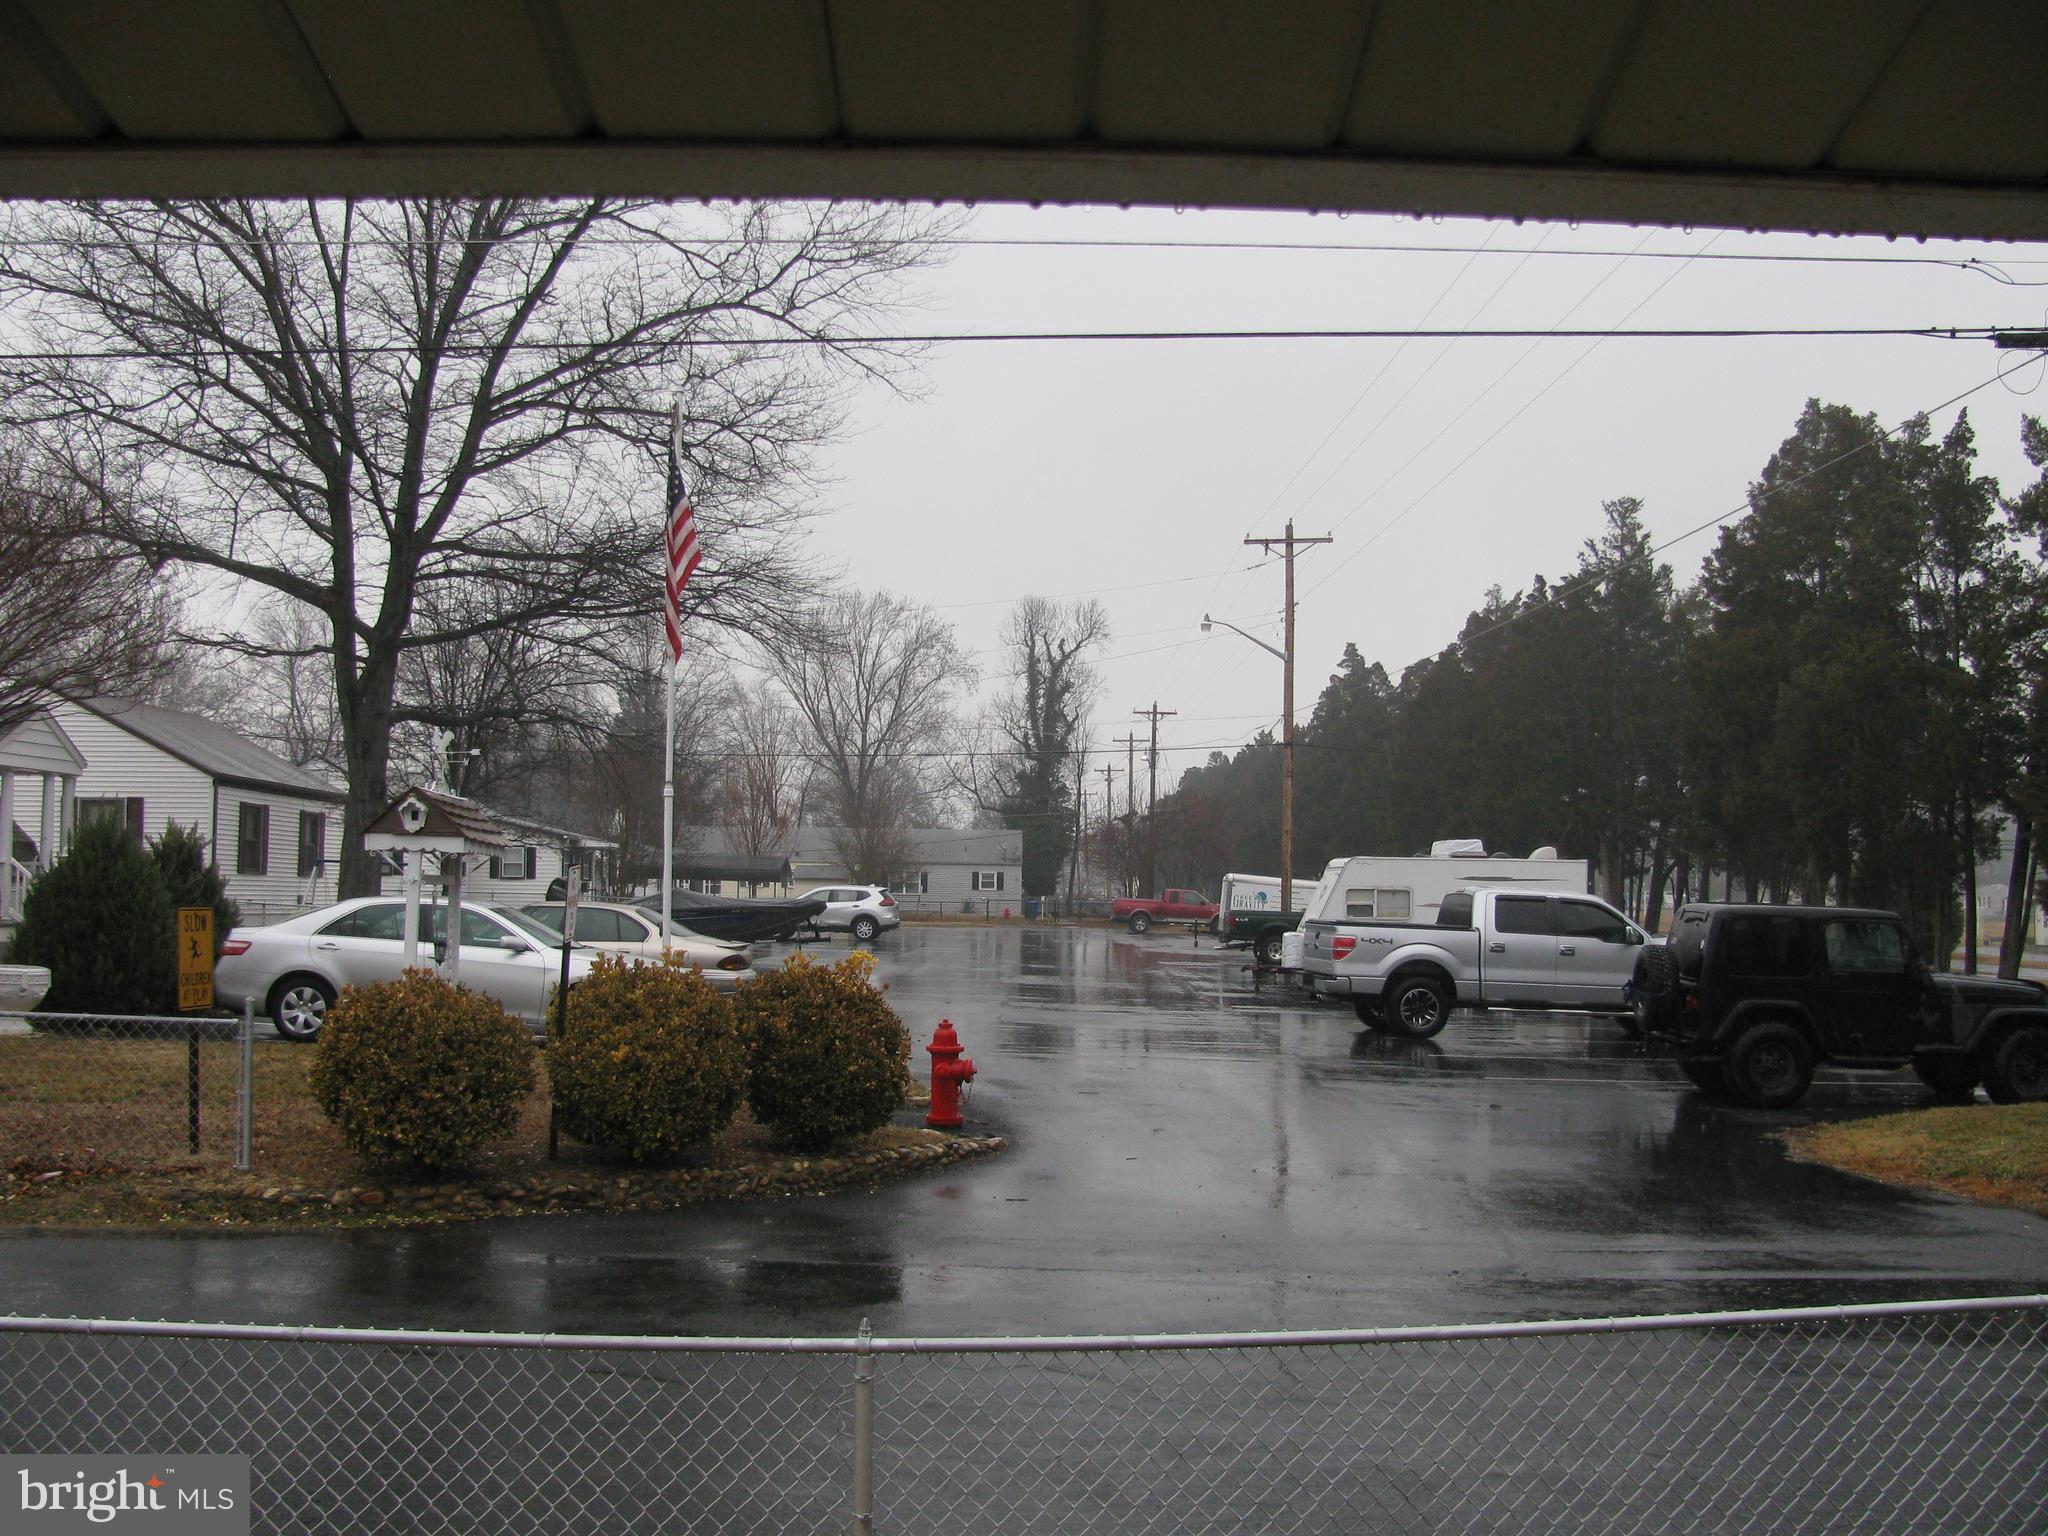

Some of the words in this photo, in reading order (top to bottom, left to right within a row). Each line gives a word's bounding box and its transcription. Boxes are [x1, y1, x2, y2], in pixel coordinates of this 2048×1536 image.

[184, 913, 208, 932] SLOW
[181, 972, 212, 986] CHILDREN
[192, 987, 209, 1002] PLAY
